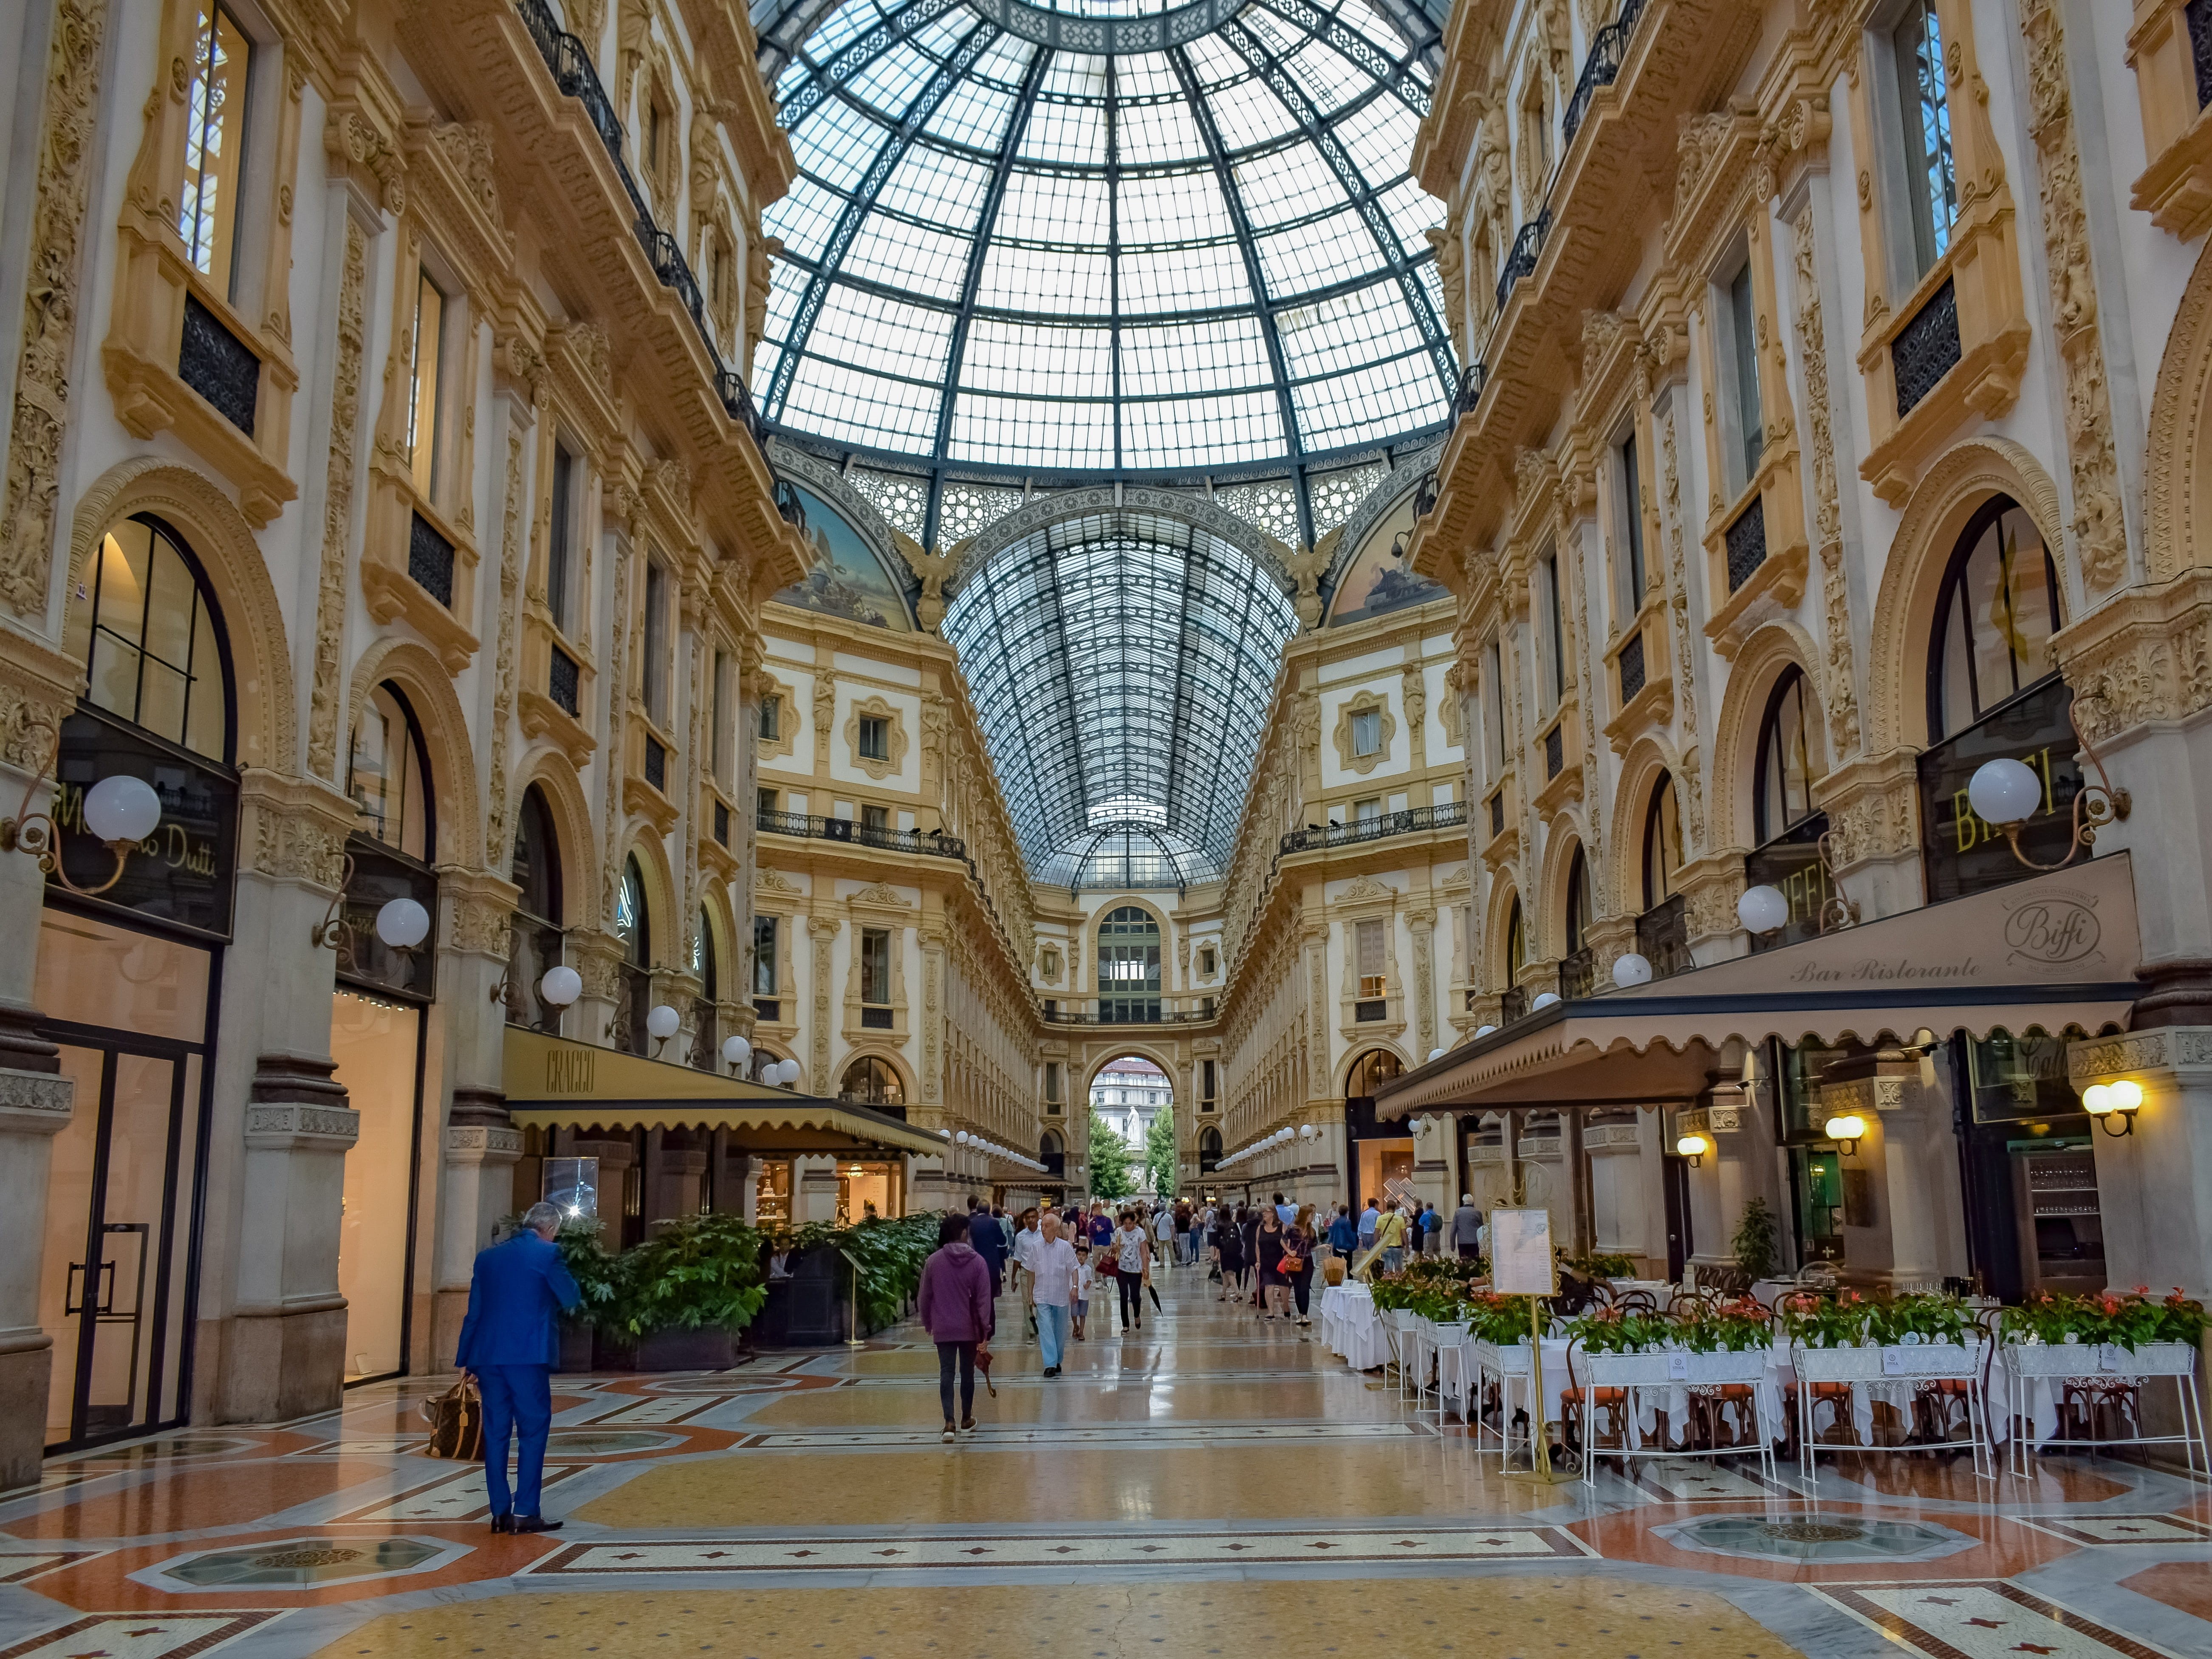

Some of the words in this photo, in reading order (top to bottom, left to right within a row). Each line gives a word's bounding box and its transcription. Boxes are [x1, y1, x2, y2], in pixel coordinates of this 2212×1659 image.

[165, 823, 217, 879] Dutti
[2016, 906, 2088, 959] Biffi
[1791, 961, 1845, 982] Bar
[1852, 956, 1982, 981] Ristorante
[547, 1050, 594, 1093] CRACCO
